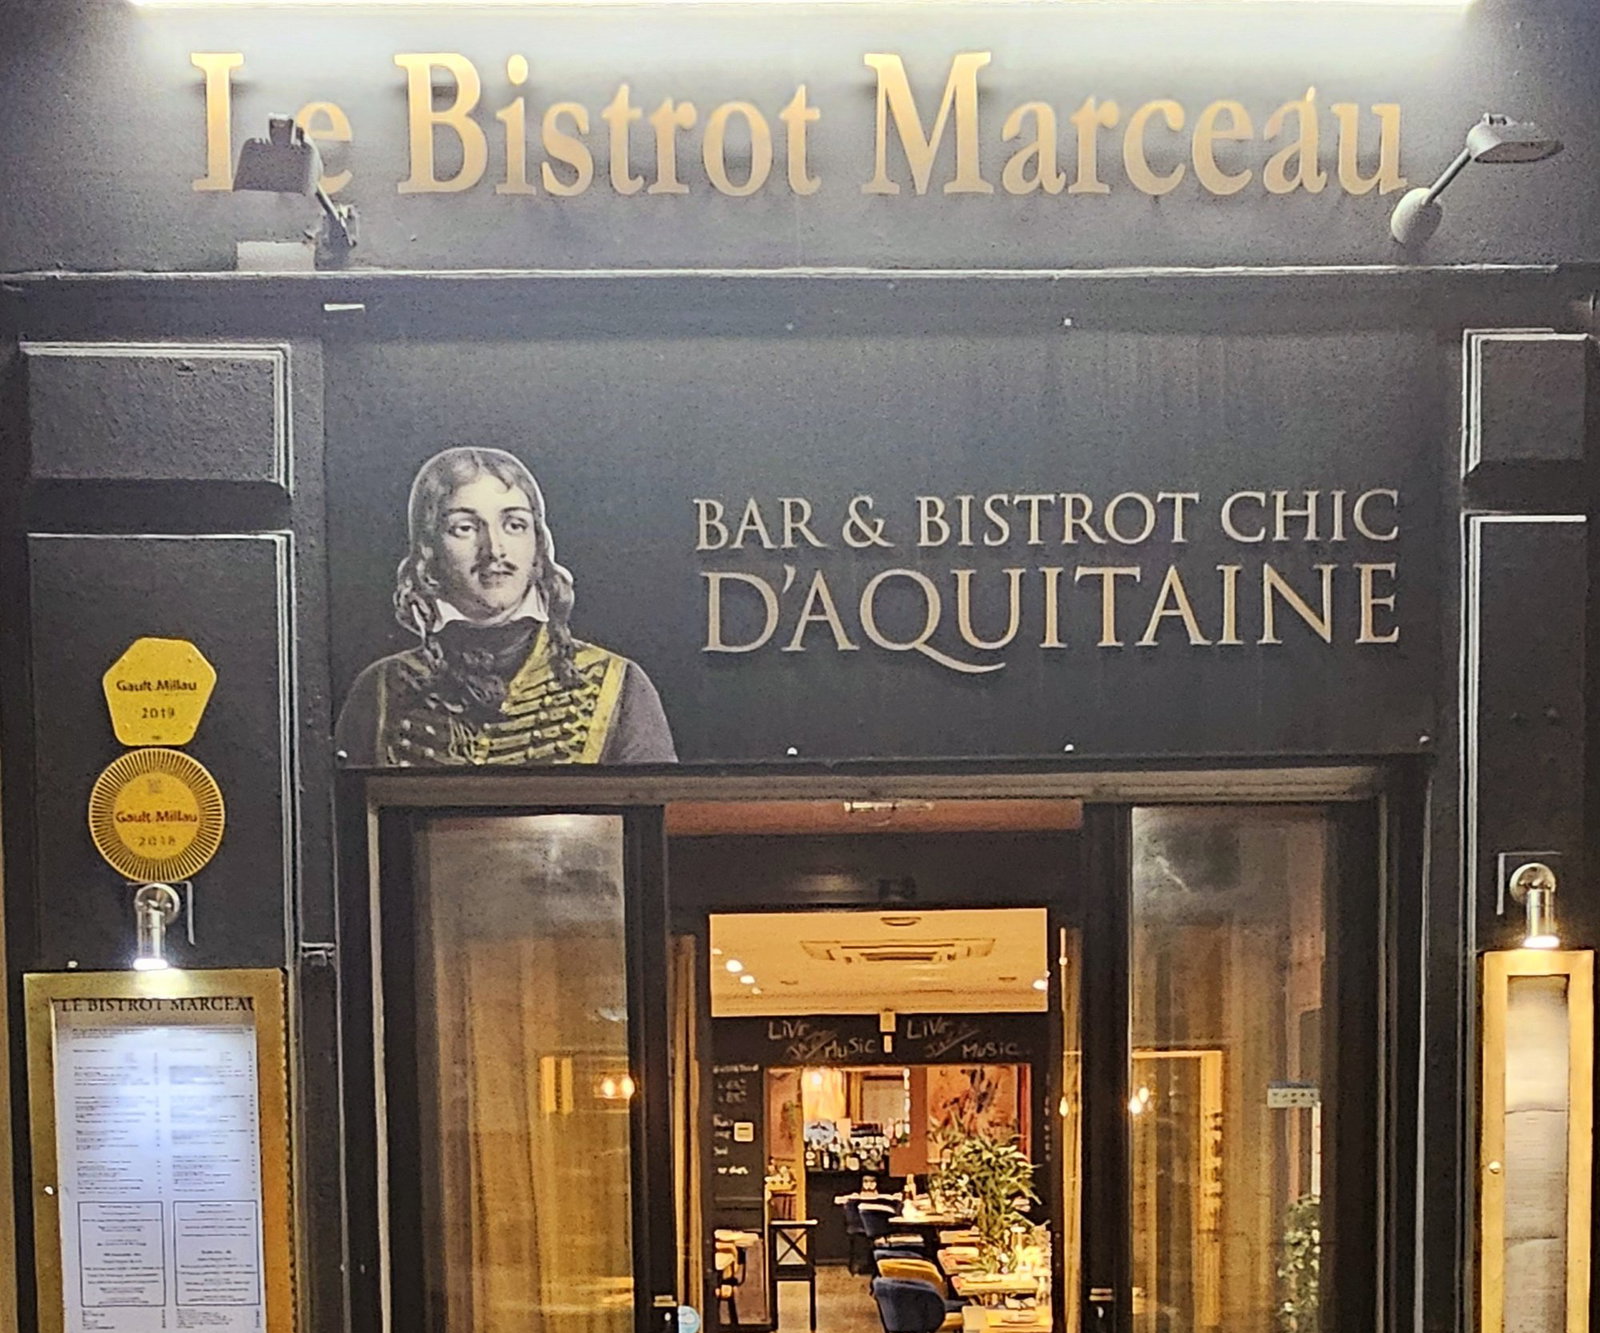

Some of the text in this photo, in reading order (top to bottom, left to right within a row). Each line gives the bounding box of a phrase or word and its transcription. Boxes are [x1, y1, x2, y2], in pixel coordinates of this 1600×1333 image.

[393, 51, 823, 197] Bistrot
[861, 50, 1410, 196] Marceau
[694, 488, 1401, 550] BAR & BISTROT CHIC
[700, 562, 1402, 674] D'AQUITAINE
[141, 706, 176, 719] 2019
[138, 836, 177, 847] 2018
[61, 997, 83, 1012] LE
[87, 997, 163, 1012] BISTROT
